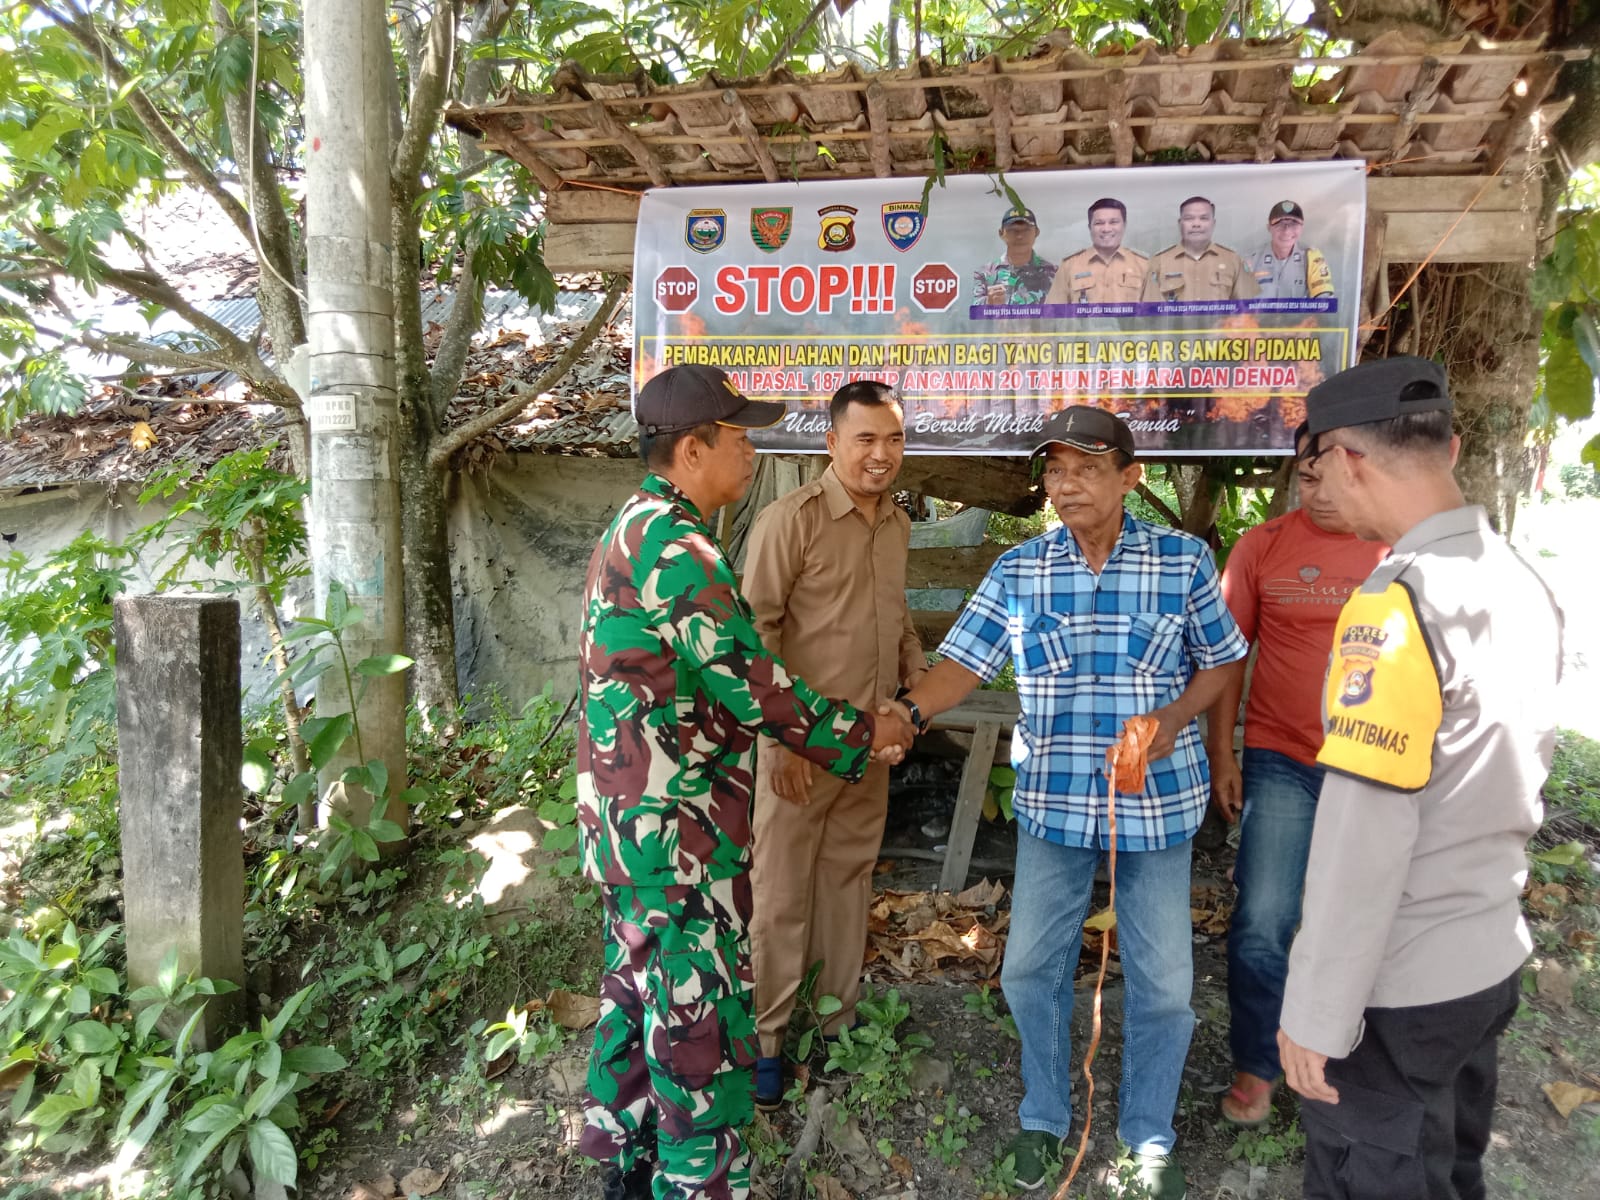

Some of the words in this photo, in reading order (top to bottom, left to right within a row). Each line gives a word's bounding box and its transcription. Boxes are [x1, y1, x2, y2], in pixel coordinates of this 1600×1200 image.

[657, 280, 697, 296] STOP
[713, 263, 897, 315] STOP!!!
[914, 278, 957, 294] STOP
[663, 344, 781, 366] PEMBAKARAN
[785, 344, 844, 367] LAHAN
[848, 344, 884, 366] DAN
[888, 343, 951, 366] HUTAN
[955, 343, 998, 366] BAGI
[1003, 342, 1052, 365] YANG
[1057, 340, 1175, 365] MELANGGAR
[1178, 338, 1250, 363] SANKSI
[1253, 338, 1322, 362] PIDANA
[751, 371, 808, 391] PASAL
[812, 371, 845, 391] 187
[903, 369, 994, 391] ANCAMAN
[999, 369, 1023, 390] 20
[1026, 368, 1089, 390] TAHUN
[1095, 366, 1186, 389] PENJARA
[1189, 365, 1231, 388] DAN
[1234, 364, 1298, 388] DENDA
[914, 411, 977, 433] Bersih
